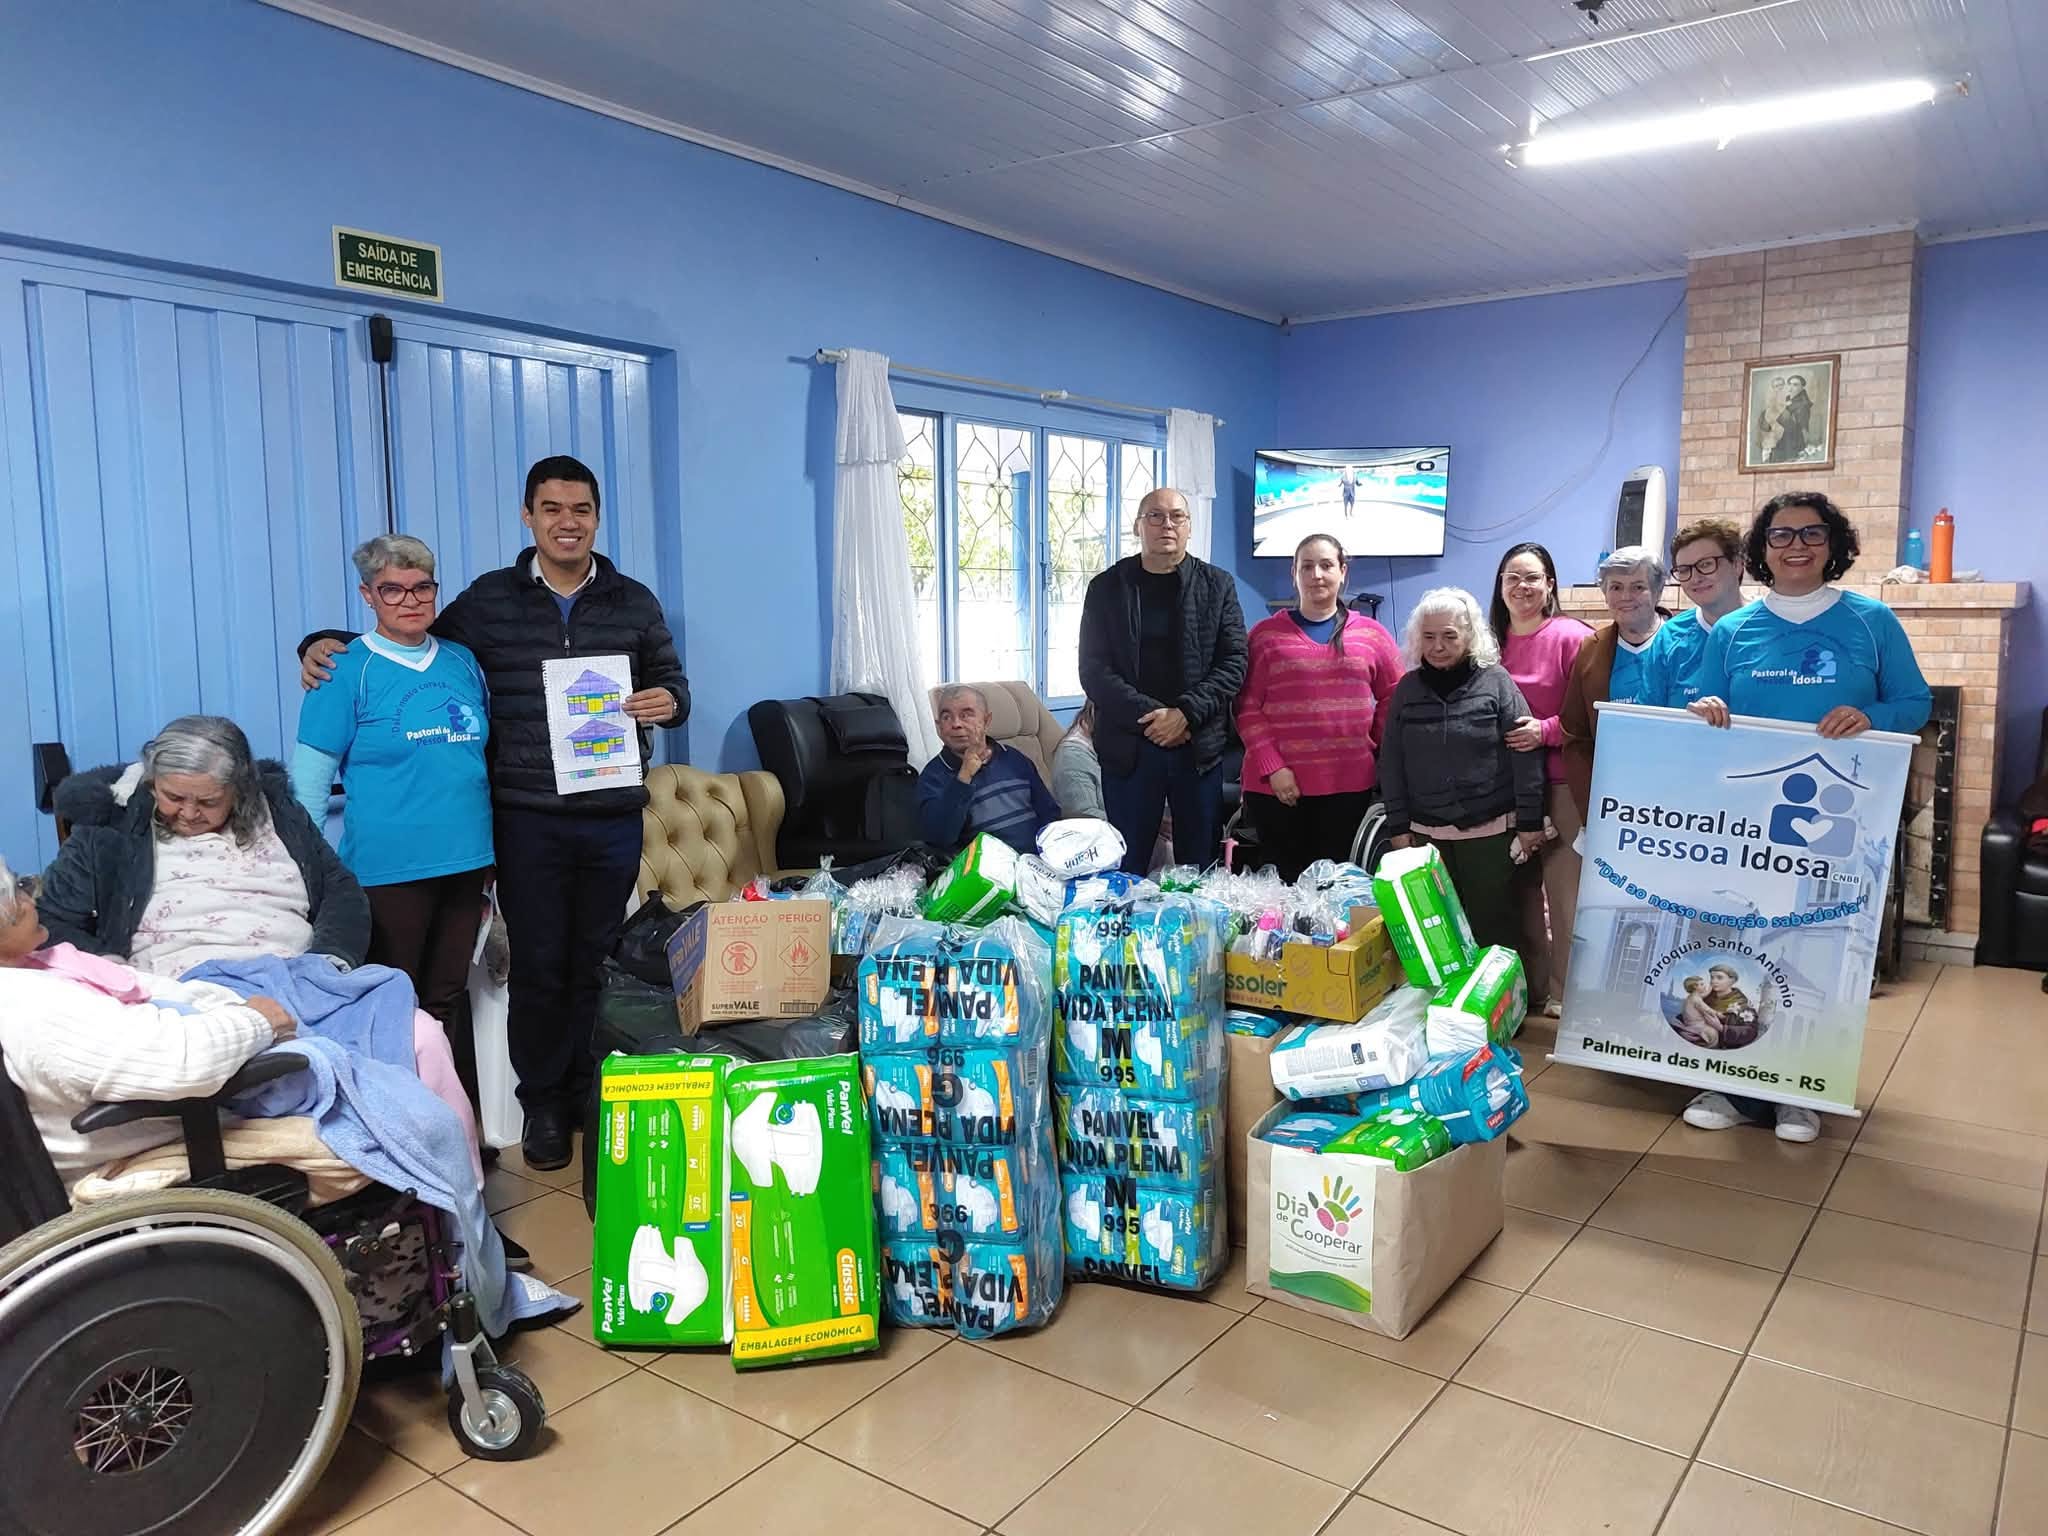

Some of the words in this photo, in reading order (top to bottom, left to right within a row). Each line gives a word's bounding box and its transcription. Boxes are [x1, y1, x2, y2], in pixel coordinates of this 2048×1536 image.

[357, 242, 398, 264] SAÍDA
[400, 251, 418, 268] DE
[346, 261, 432, 290] EMERGÊNCIA
[1751, 668, 1787, 678] Pastoral
[1792, 674, 1823, 685] Idosa
[406, 726, 442, 740] Pastoral
[447, 733, 471, 743] Idosa
[1600, 797, 1726, 835] Pastoral
[1730, 817, 1762, 839] da
[1617, 828, 1728, 865] Pessoa
[1740, 845, 1830, 879] Idosa
[1832, 873, 1860, 885] CNBB
[712, 913, 768, 927] ATENÇÃO
[778, 913, 822, 923] PERIGO
[1625, 882, 1648, 900] ao
[1648, 893, 1697, 919] nosso
[1700, 911, 1768, 931] coração
[1099, 921, 1133, 938] 995
[876, 954, 950, 985] PENA
[958, 957, 1019, 986] VIDA
[1079, 964, 1154, 990] PANVEL
[1644, 940, 1702, 986] Paróquia
[1708, 936, 1753, 955] Santo
[1755, 952, 1793, 1009] Antônio
[900, 988, 991, 1020] PANVEL
[1057, 996, 1106, 1021] VIDA
[1112, 996, 1176, 1022] PLENA
[1101, 1027, 1132, 1059] M
[1100, 1066, 1135, 1083] 995
[1582, 1037, 1661, 1063] Palmeira
[1667, 1052, 1700, 1069] das
[1705, 1058, 1780, 1084] Missões
[1799, 1075, 1826, 1092] RS
[656, 1081, 711, 1091] EMBALAGEM
[932, 1072, 963, 1108] G
[839, 1080, 854, 1135] PanVel
[614, 1111, 626, 1158] Classic
[878, 1106, 952, 1141] PLENA
[962, 1115, 1016, 1145] VIDA
[1081, 1109, 1159, 1139] PANVEL
[689, 1157, 699, 1169] M
[900, 1143, 994, 1179] PANVEL
[1065, 1139, 1109, 1169] VIDA
[1114, 1144, 1183, 1174] PLENA
[1104, 1175, 1137, 1210] M
[1276, 1191, 1309, 1218] Dia
[1104, 1214, 1140, 1235] 995
[1276, 1212, 1288, 1222] de
[937, 1229, 965, 1264] G
[1291, 1219, 1363, 1255] Cooperar
[841, 1255, 857, 1305] Classic
[1084, 1257, 1168, 1286] PANVEL
[961, 1273, 1023, 1303] VIDA
[602, 1277, 613, 1333] PanVel
[915, 1290, 995, 1332] PANVEL
[740, 1335, 802, 1352] EMBALAGEM
